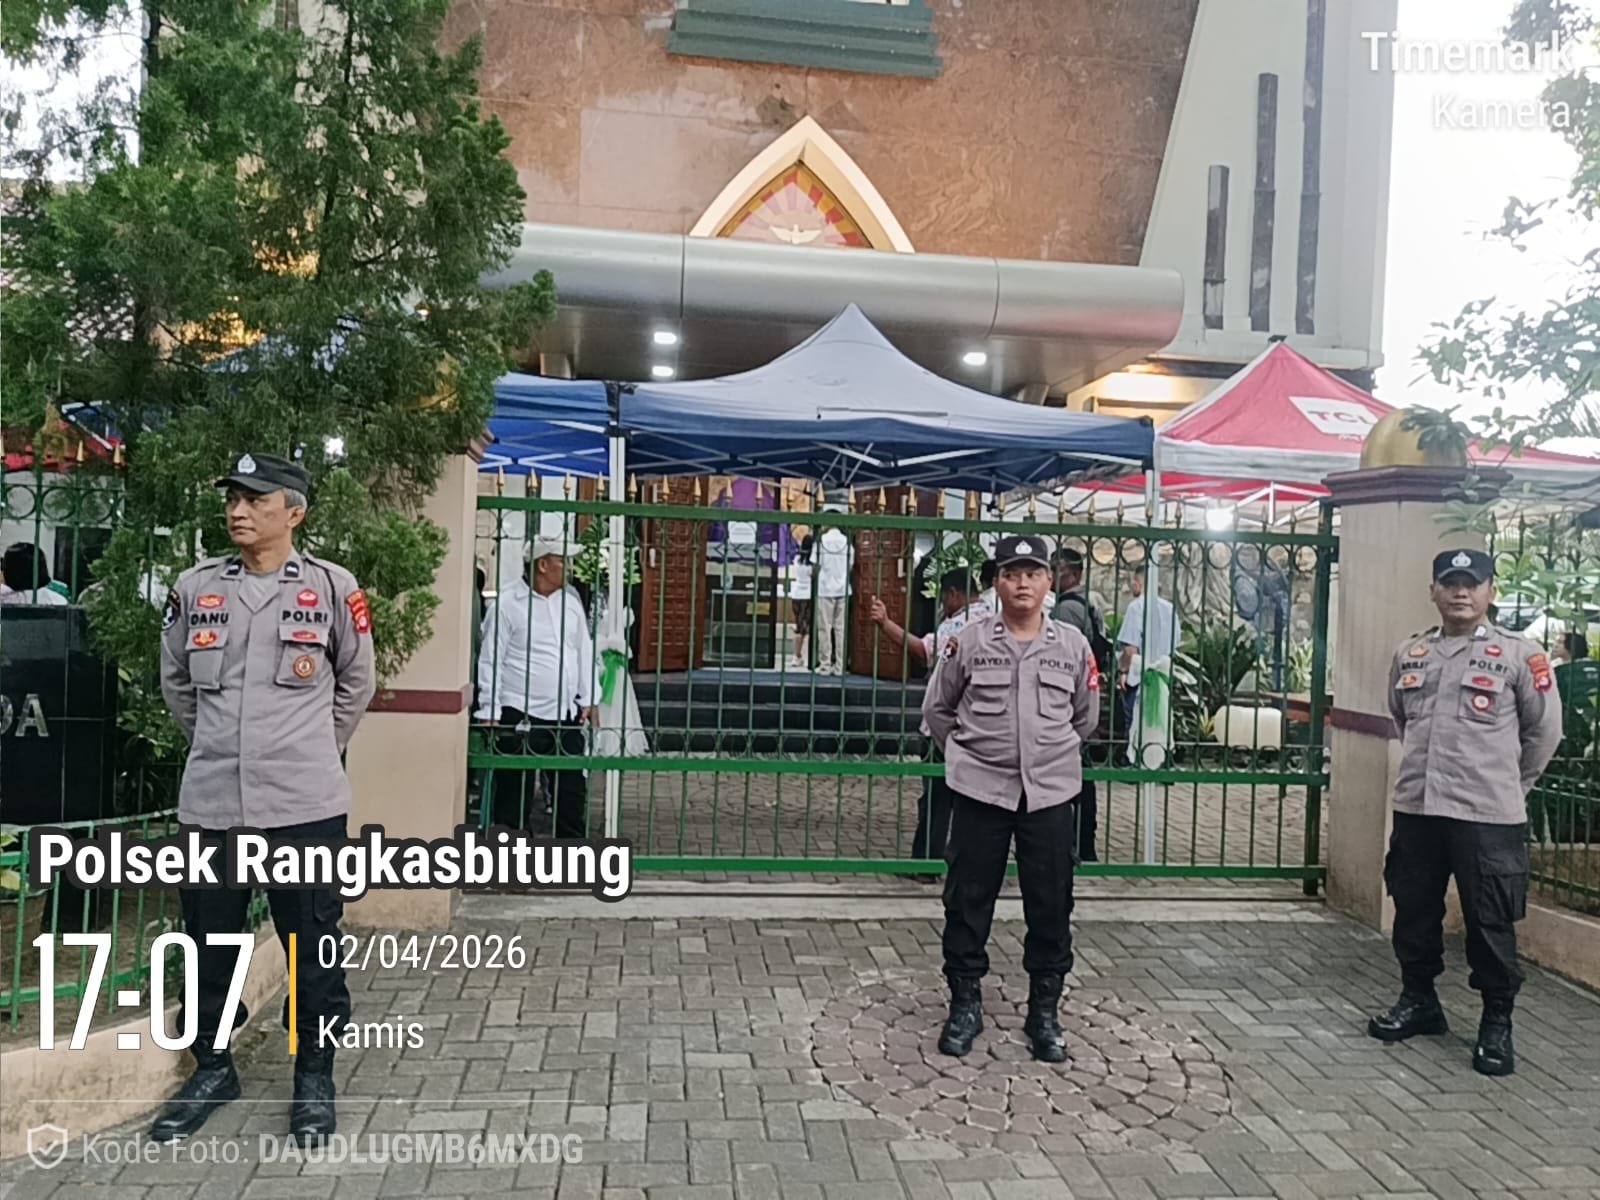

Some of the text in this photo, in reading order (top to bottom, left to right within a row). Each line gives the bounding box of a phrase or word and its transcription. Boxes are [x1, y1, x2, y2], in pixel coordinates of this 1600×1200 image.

[190, 611, 229, 626] DANU
[281, 609, 328, 624] POLRI
[1039, 658, 1075, 672] POLRI
[1468, 658, 1509, 675] POLRI
